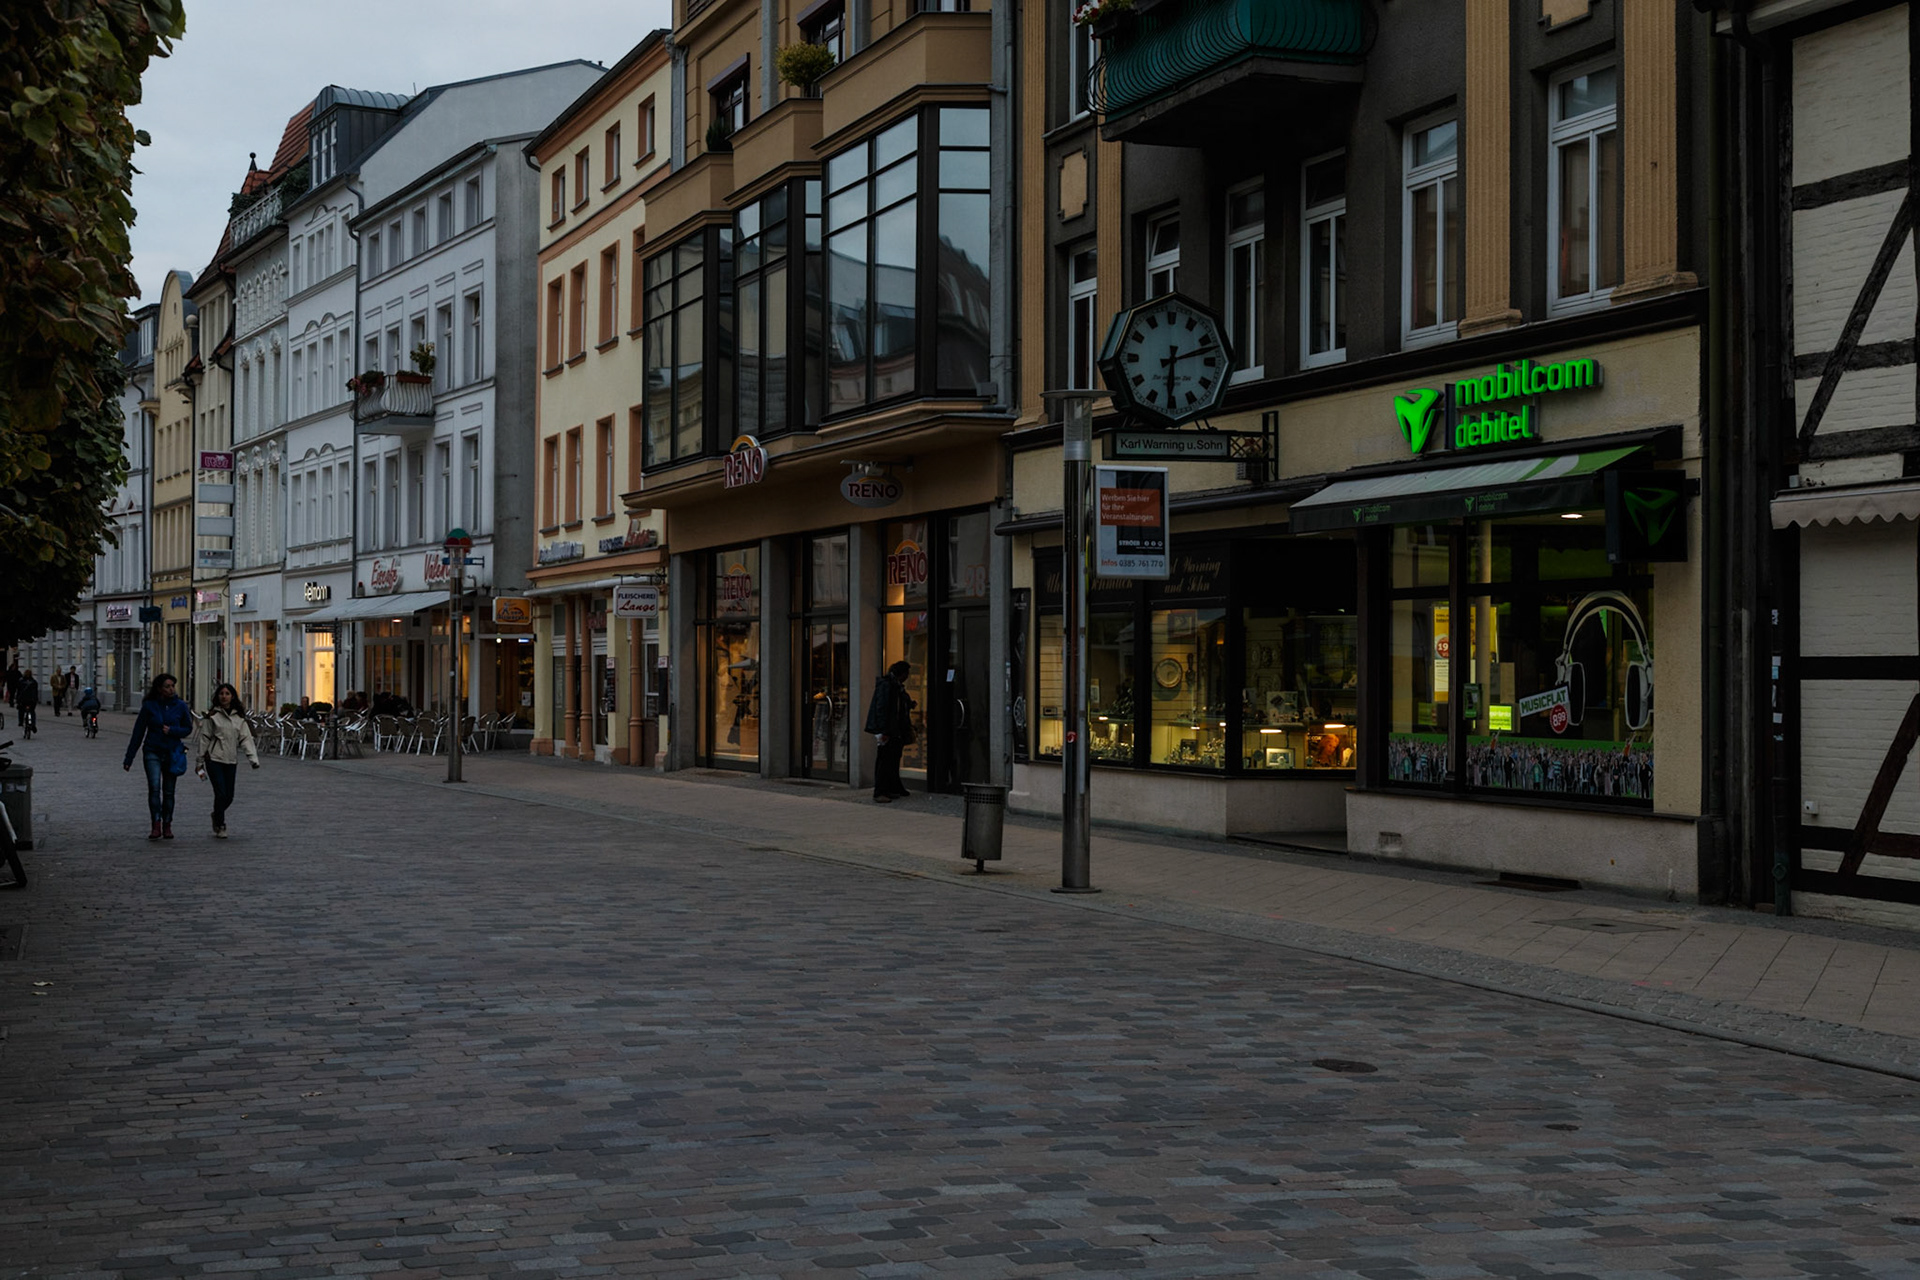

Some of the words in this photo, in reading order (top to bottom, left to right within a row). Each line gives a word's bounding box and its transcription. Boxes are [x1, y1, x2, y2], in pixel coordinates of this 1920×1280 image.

[1456, 358, 1594, 406] mobilcom
[1455, 404, 1534, 448] debitel
[1120, 439, 1140, 449] Karl
[1142, 439, 1184, 451] Warning
[723, 447, 764, 489] RENO
[848, 483, 898, 498] RENO
[1101, 494, 1126, 502] Werben
[1127, 494, 1138, 502] Sie
[1101, 513, 1154, 522] Veranstaltungen
[888, 551, 928, 585] RENO
[1101, 559, 1118, 567] Infos
[1119, 560, 1135, 568] 0385
[1138, 560, 1149, 568] 761
[723, 574, 751, 600] RENO
[964, 564, 986, 598] 28
[619, 600, 656, 612] Lange
[1521, 690, 1567, 713] MUSICFLAT
